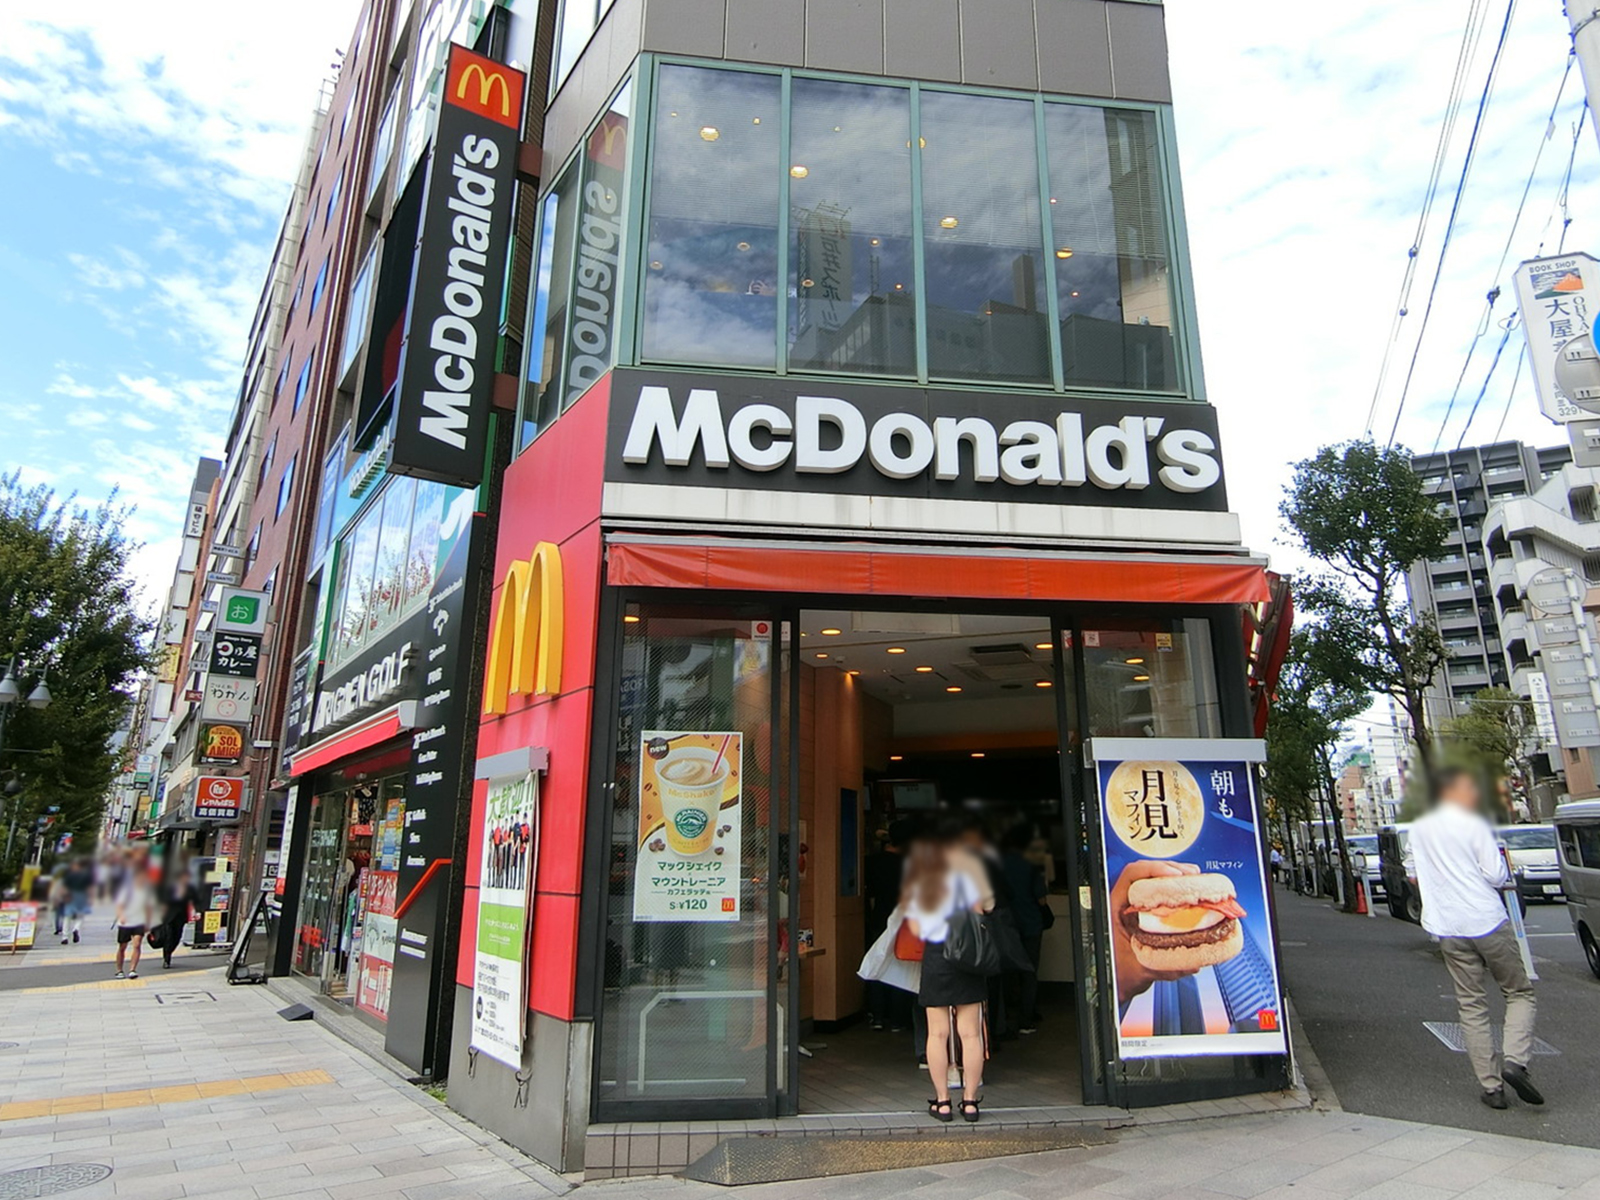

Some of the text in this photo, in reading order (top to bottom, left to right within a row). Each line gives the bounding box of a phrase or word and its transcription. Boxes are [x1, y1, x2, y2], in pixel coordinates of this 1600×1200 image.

[1529, 260, 1576, 273] BOOK SHOP
[419, 134, 499, 450] McDonald's
[623, 385, 1220, 492] McDonald's
[218, 657, 252, 668] カレー
[367, 642, 412, 702] GOLF
[219, 736, 238, 747] SOL
[1140, 769, 1178, 841] 月見
[1209, 770, 1235, 818] 朝も
[1124, 790, 1143, 840] マフィン
[658, 862, 722, 871] マックシェイク
[1206, 861, 1243, 870] 月見マフィン
[651, 877, 726, 887] マウントレーニア
